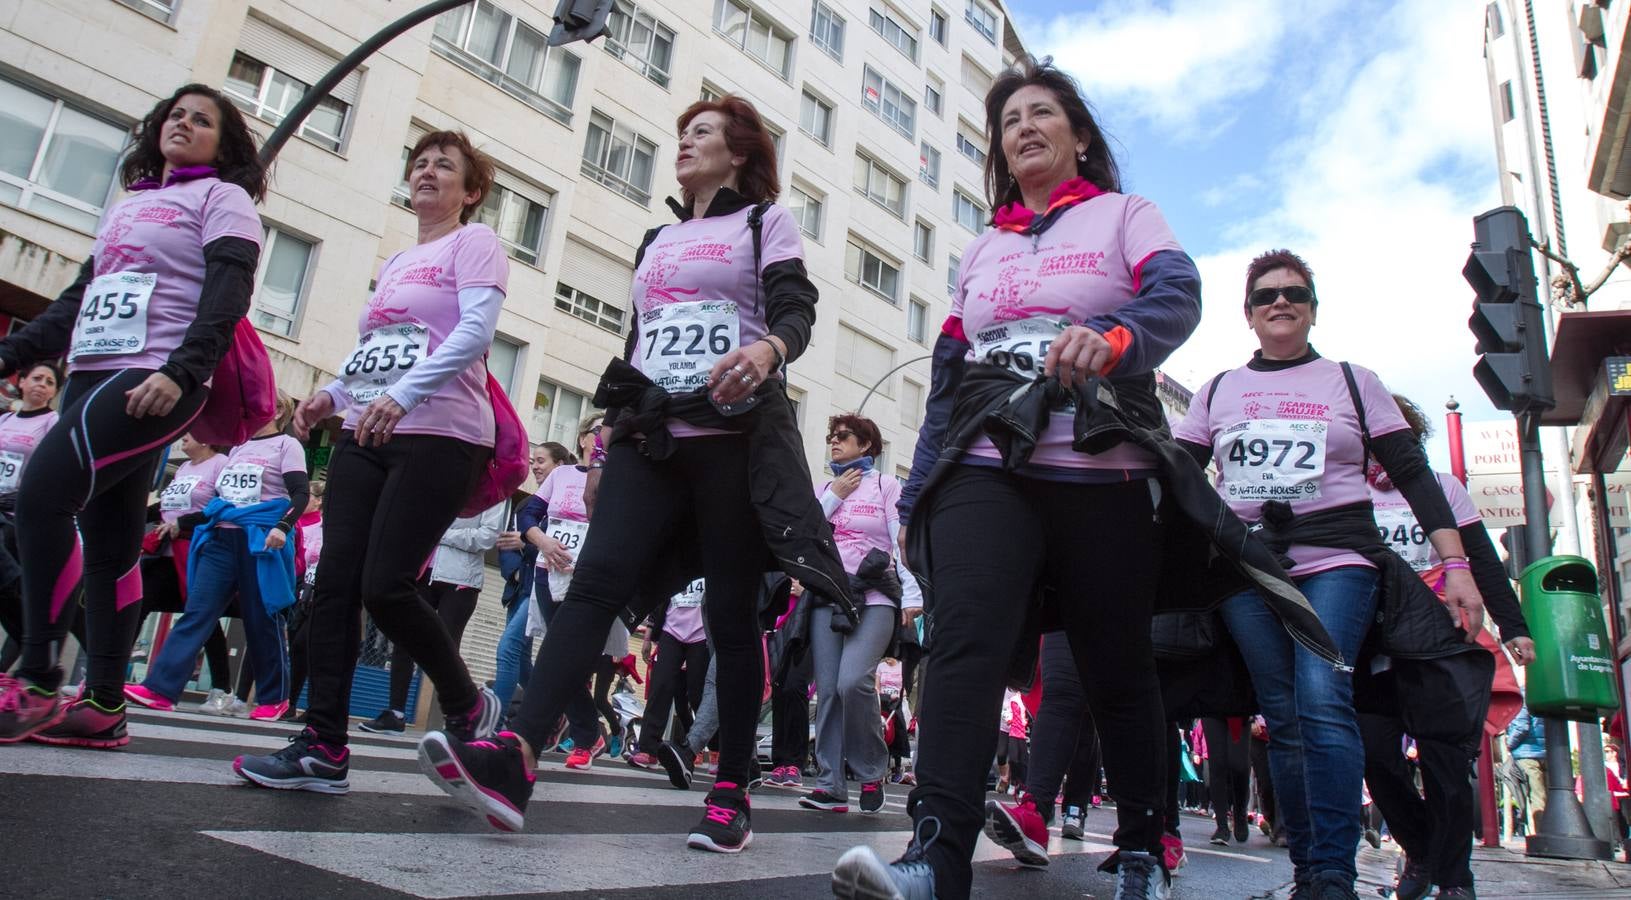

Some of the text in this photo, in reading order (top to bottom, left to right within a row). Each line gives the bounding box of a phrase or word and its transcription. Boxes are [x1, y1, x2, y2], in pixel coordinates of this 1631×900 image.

[1047, 260, 1098, 271] MUJER
[78, 292, 141, 321] 455
[646, 324, 731, 361] 7226
[345, 344, 420, 376] 6655
[669, 361, 697, 370] YOLANDA
[684, 375, 711, 386] HOUS
[1283, 407, 1325, 417] MUJER
[1229, 438, 1317, 470] 4972
[0, 461, 16, 478] 79
[220, 474, 257, 488] 6165
[1269, 485, 1304, 495] HOUSE
[1478, 507, 1526, 518] ANTIG
[1578, 662, 1589, 670] de
